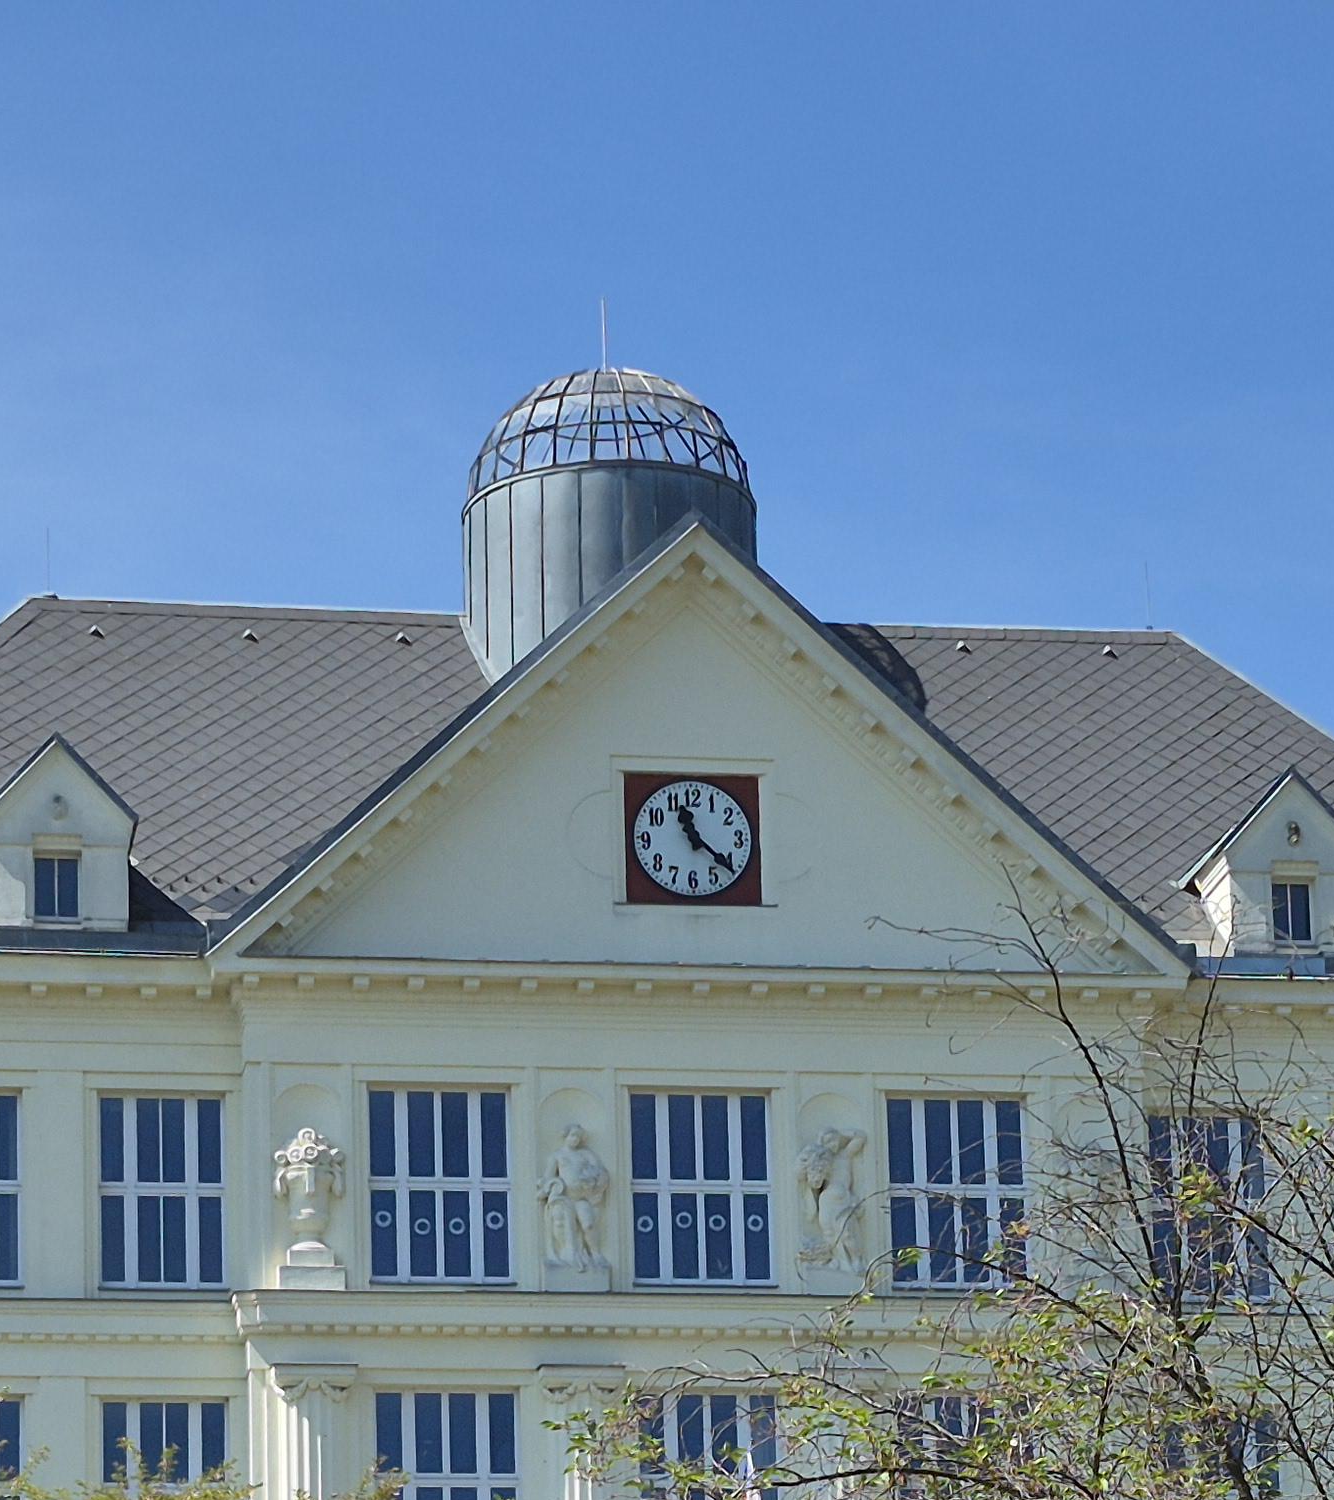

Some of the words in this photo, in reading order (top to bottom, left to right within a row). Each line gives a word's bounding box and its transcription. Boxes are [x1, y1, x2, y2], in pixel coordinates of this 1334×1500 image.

[667, 792, 679, 812] 11
[684, 788, 702, 808] 12
[708, 793, 715, 813] 1
[648, 807, 665, 827] 10
[722, 807, 734, 826] 2
[640, 831, 651, 850] 9
[733, 829, 744, 849] 3
[652, 853, 663, 872] 8
[668, 865, 679, 885] 7
[687, 870, 699, 889] 6
[708, 866, 719, 885] 5
